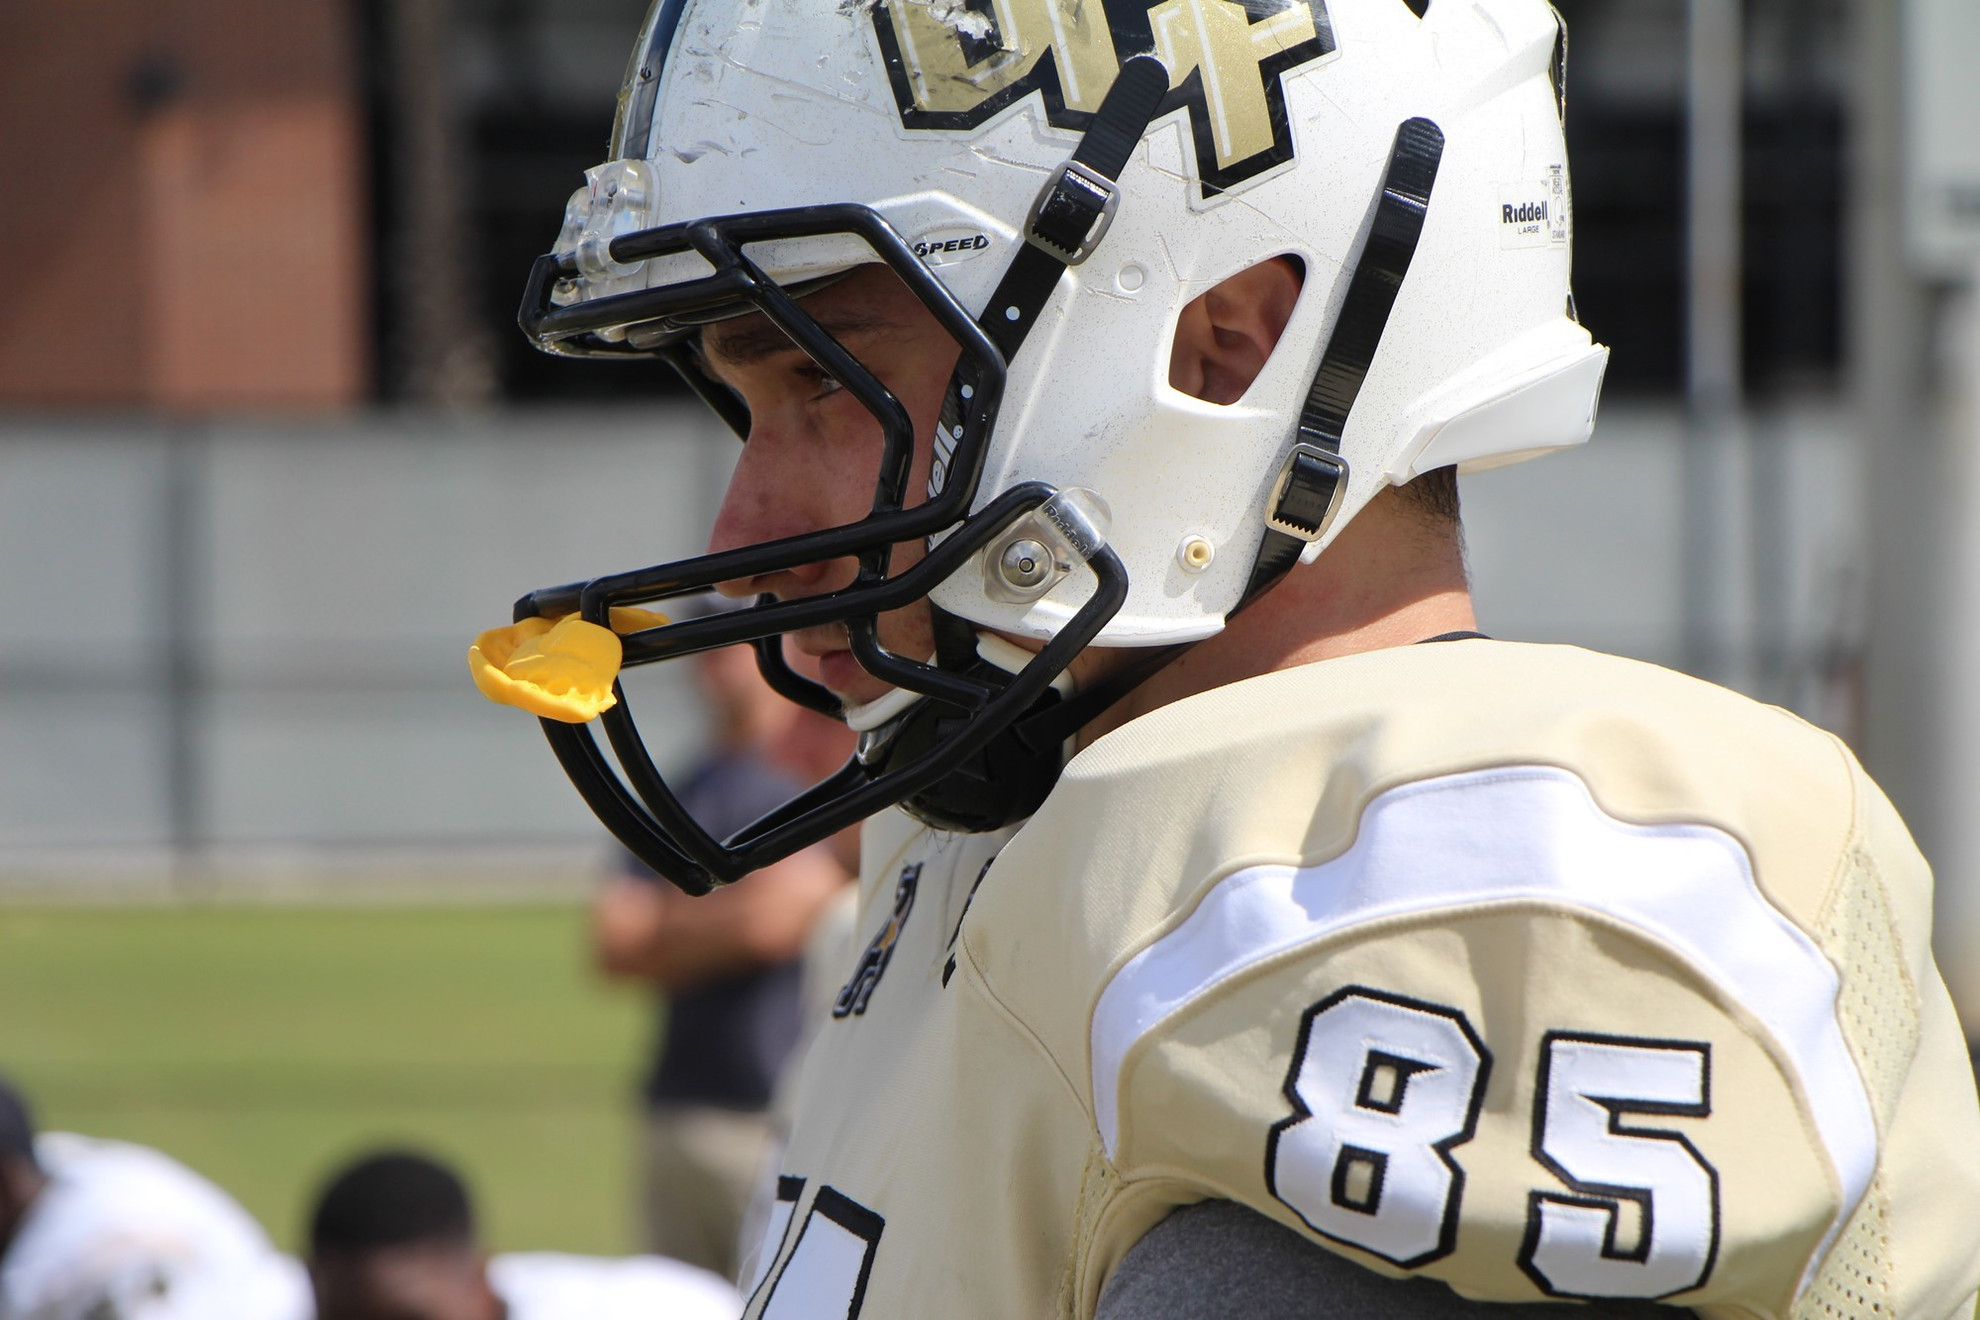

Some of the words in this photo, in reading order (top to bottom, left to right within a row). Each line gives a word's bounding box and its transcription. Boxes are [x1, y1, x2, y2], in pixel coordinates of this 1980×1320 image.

[1502, 200, 1548, 224] Riddell
[1517, 225, 1540, 235] LARGE
[914, 234, 990, 257] SPEED
[1264, 984, 1720, 1304] 85
